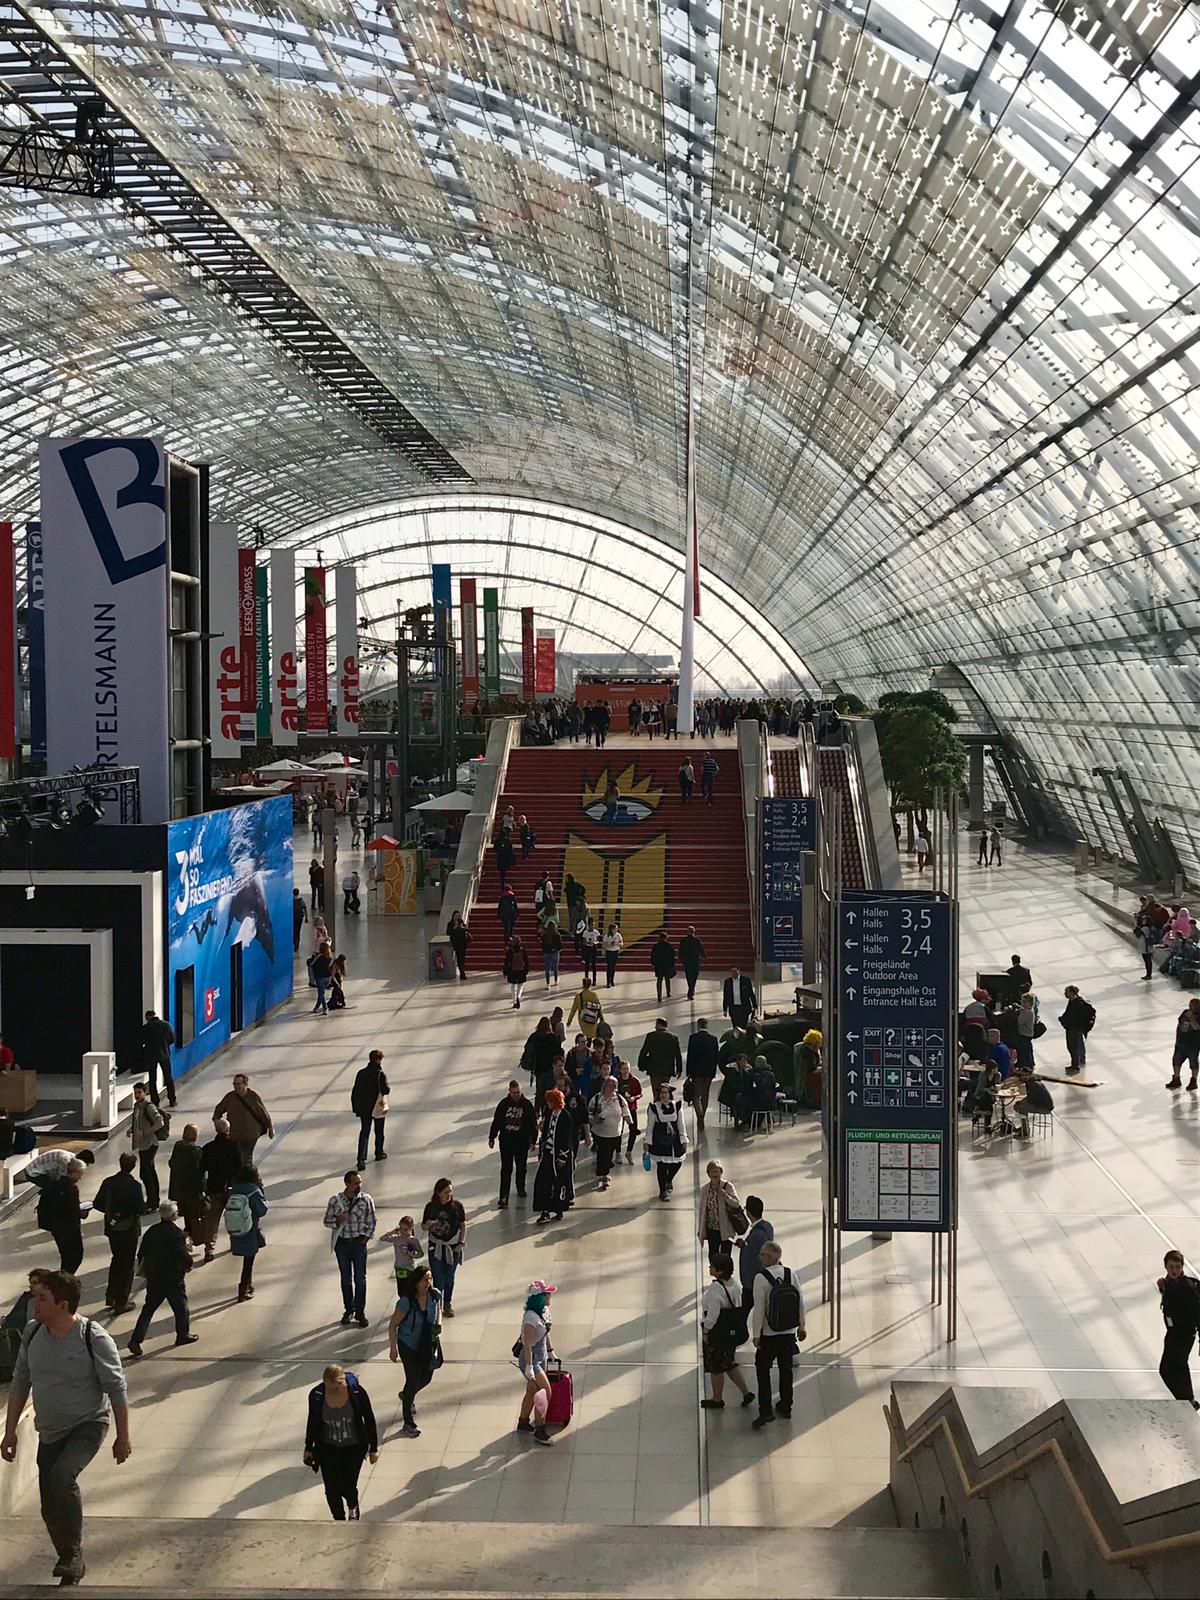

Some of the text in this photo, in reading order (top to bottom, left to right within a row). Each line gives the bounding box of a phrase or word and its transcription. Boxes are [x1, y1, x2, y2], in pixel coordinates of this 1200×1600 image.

[316, 622, 325, 669] LIEBSTEN?
[307, 662, 315, 678] WO
[317, 671, 325, 685] AM
[217, 646, 240, 740] arte
[277, 652, 299, 731] arte
[307, 681, 315, 702] UND
[317, 689, 325, 702] SIE
[341, 655, 359, 723] arte
[791, 802, 807, 814] 3,5
[791, 815, 807, 828] 2,4
[175, 850, 189, 915] 3
[189, 867, 200, 887] SO
[862, 908, 931, 931] Hallen 3,5
[862, 919, 883, 928] Halls
[862, 934, 933, 957] Hallen 2,4
[862, 945, 883, 954] Halls
[862, 960, 911, 970] Freigelände
[862, 971, 919, 980] Outdoor Area
[863, 985, 937, 997] Eingangshalle Ost
[863, 997, 937, 1007] Entrance Hall East
[885, 1052, 902, 1060] Shop
[891, 1132, 942, 1140] RETTUNGSPLAN
